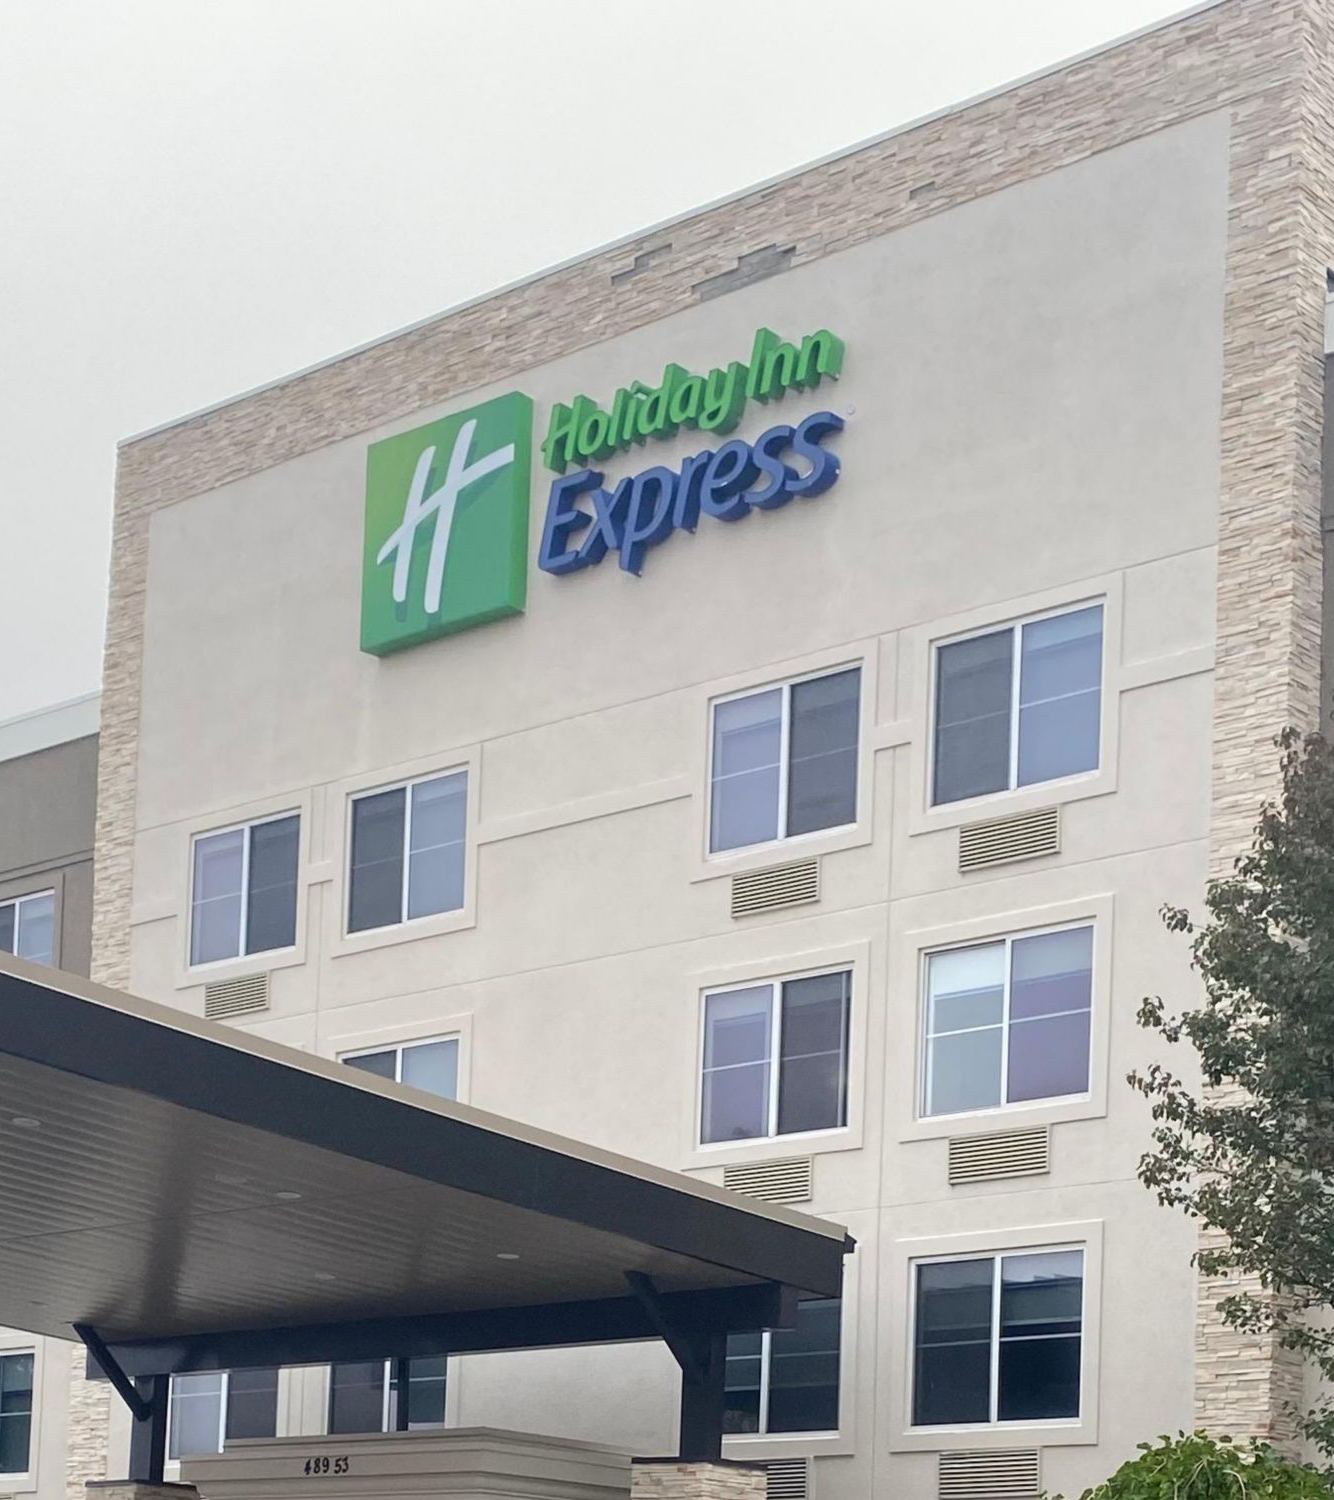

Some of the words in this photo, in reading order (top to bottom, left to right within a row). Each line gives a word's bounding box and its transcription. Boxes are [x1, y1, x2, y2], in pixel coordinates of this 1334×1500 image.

[541, 361, 750, 475] Holiday
[745, 327, 846, 405] Inn
[537, 410, 846, 577] Express
